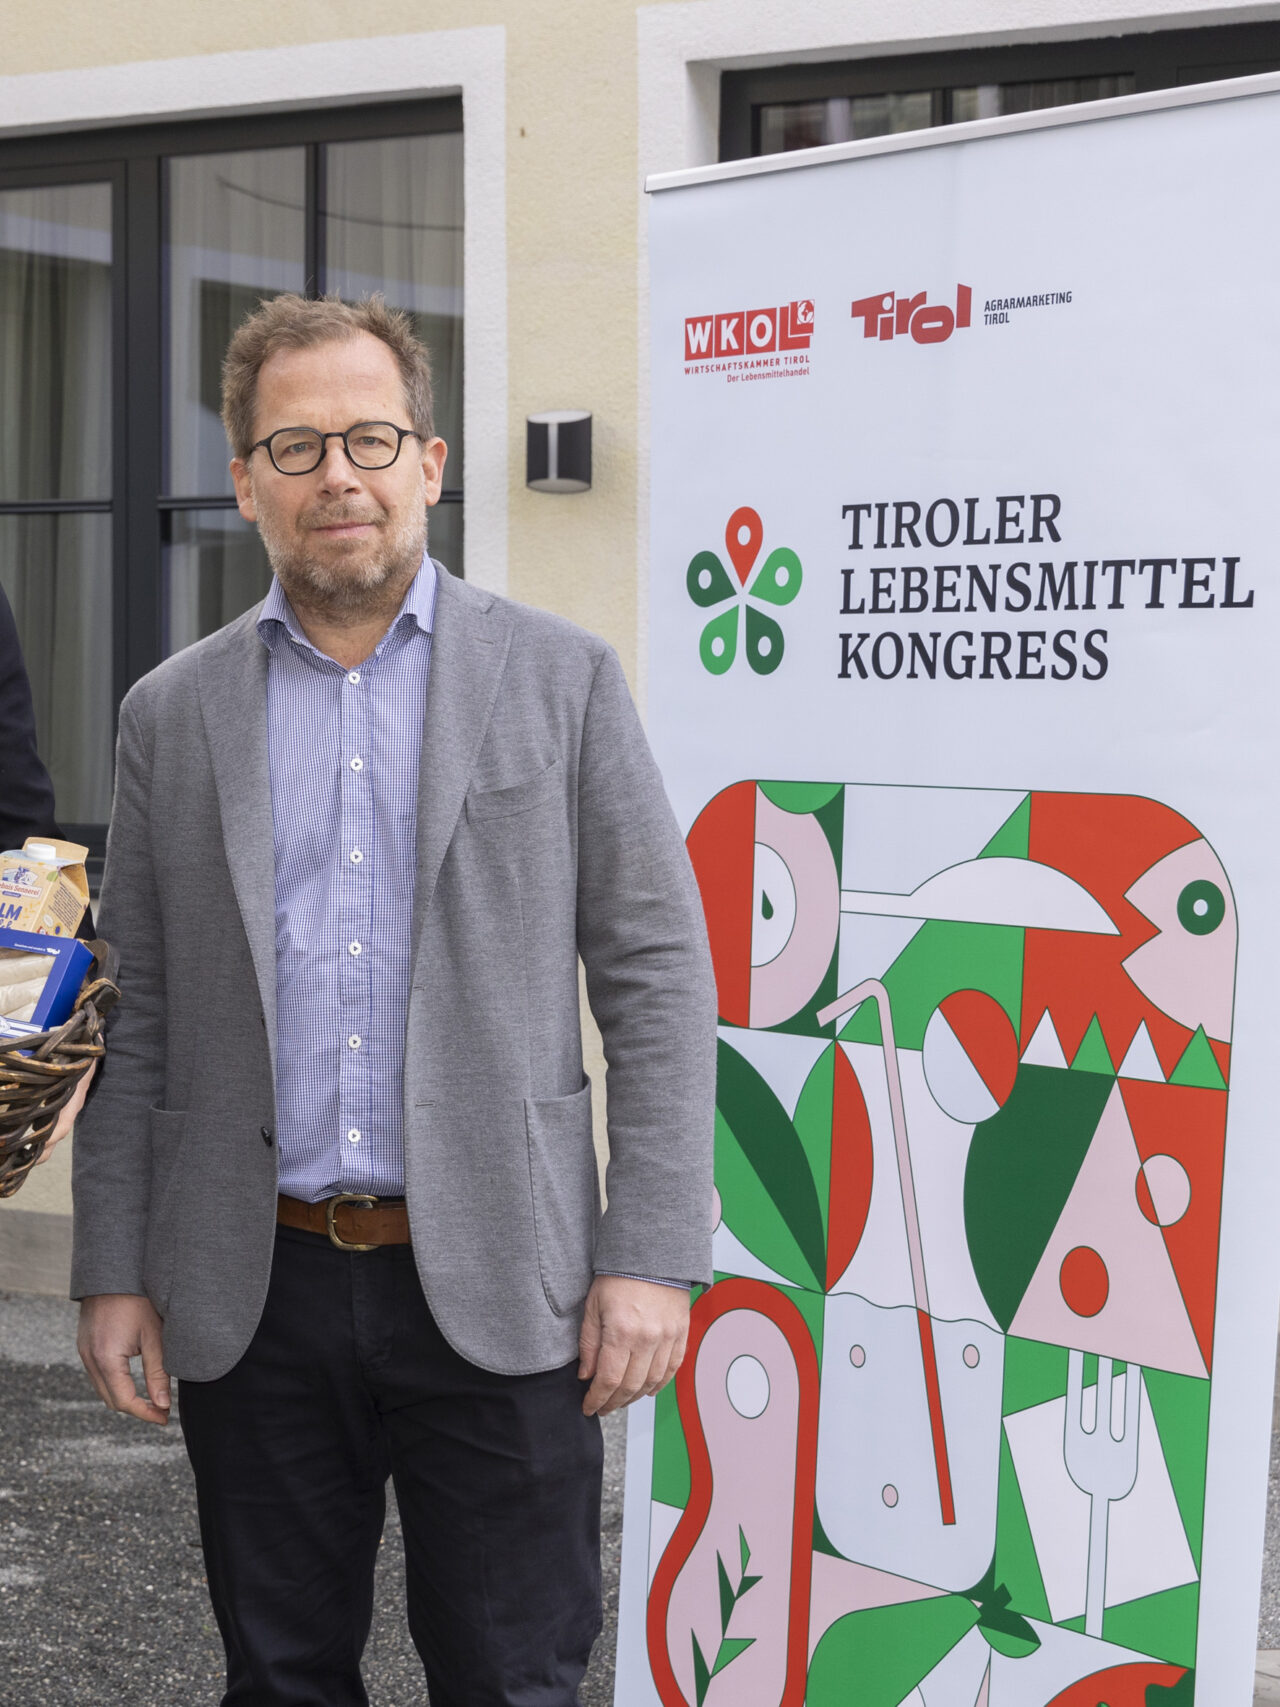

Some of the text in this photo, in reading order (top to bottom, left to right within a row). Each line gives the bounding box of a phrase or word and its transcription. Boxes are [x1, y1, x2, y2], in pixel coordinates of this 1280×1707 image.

[851, 283, 972, 344] Tirol
[984, 291, 1072, 312] AGRARMARKETING
[984, 312, 1010, 326] TIROL
[684, 354, 810, 375] WIRTSCHAFTSKAMMER TIROL
[726, 367, 810, 383] Der Lebensmittelhandel
[842, 494, 1062, 550] TIROLER
[839, 557, 1255, 614] LEBENSMITTEL
[837, 629, 1109, 681] KONGRESS
